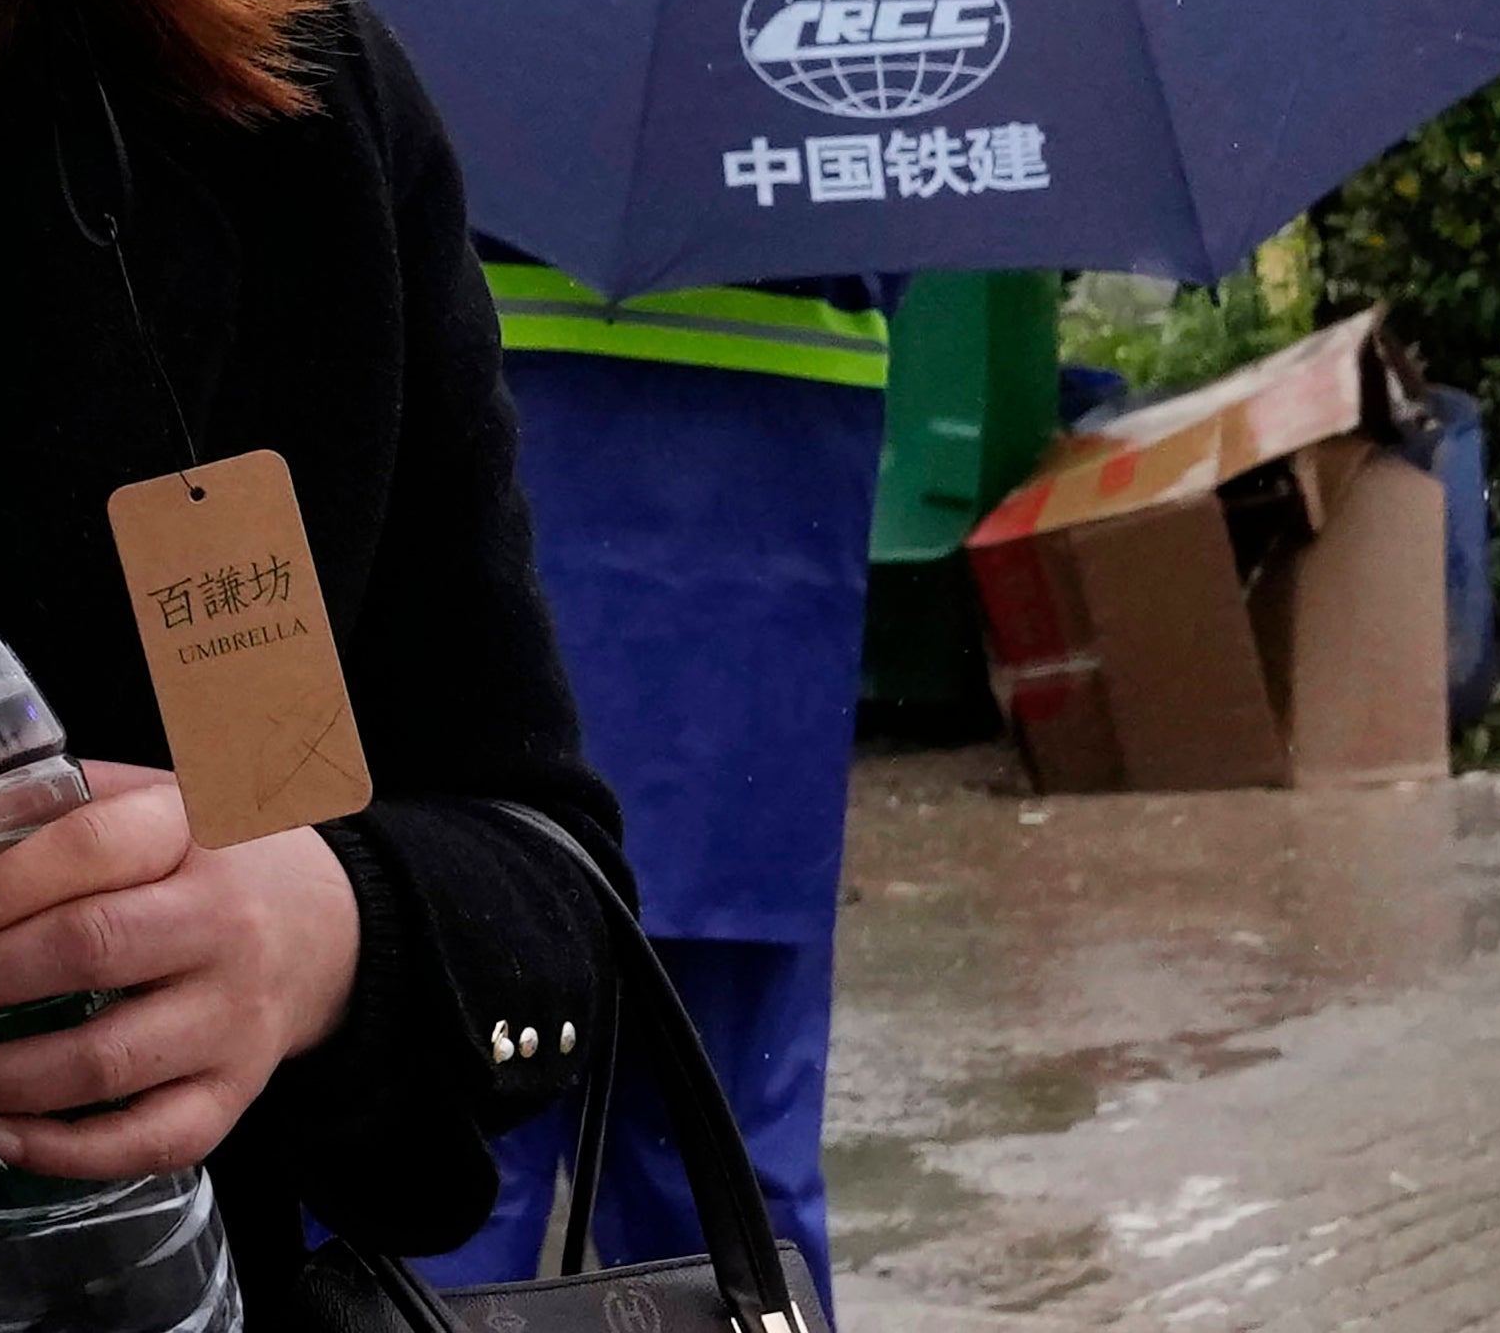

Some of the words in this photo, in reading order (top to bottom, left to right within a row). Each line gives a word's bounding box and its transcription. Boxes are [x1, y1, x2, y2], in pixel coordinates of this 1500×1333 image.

[722, 121, 1051, 207] 中国铁建
[147, 554, 291, 629] 百謙坊
[177, 617, 309, 665] UMBRELLA
